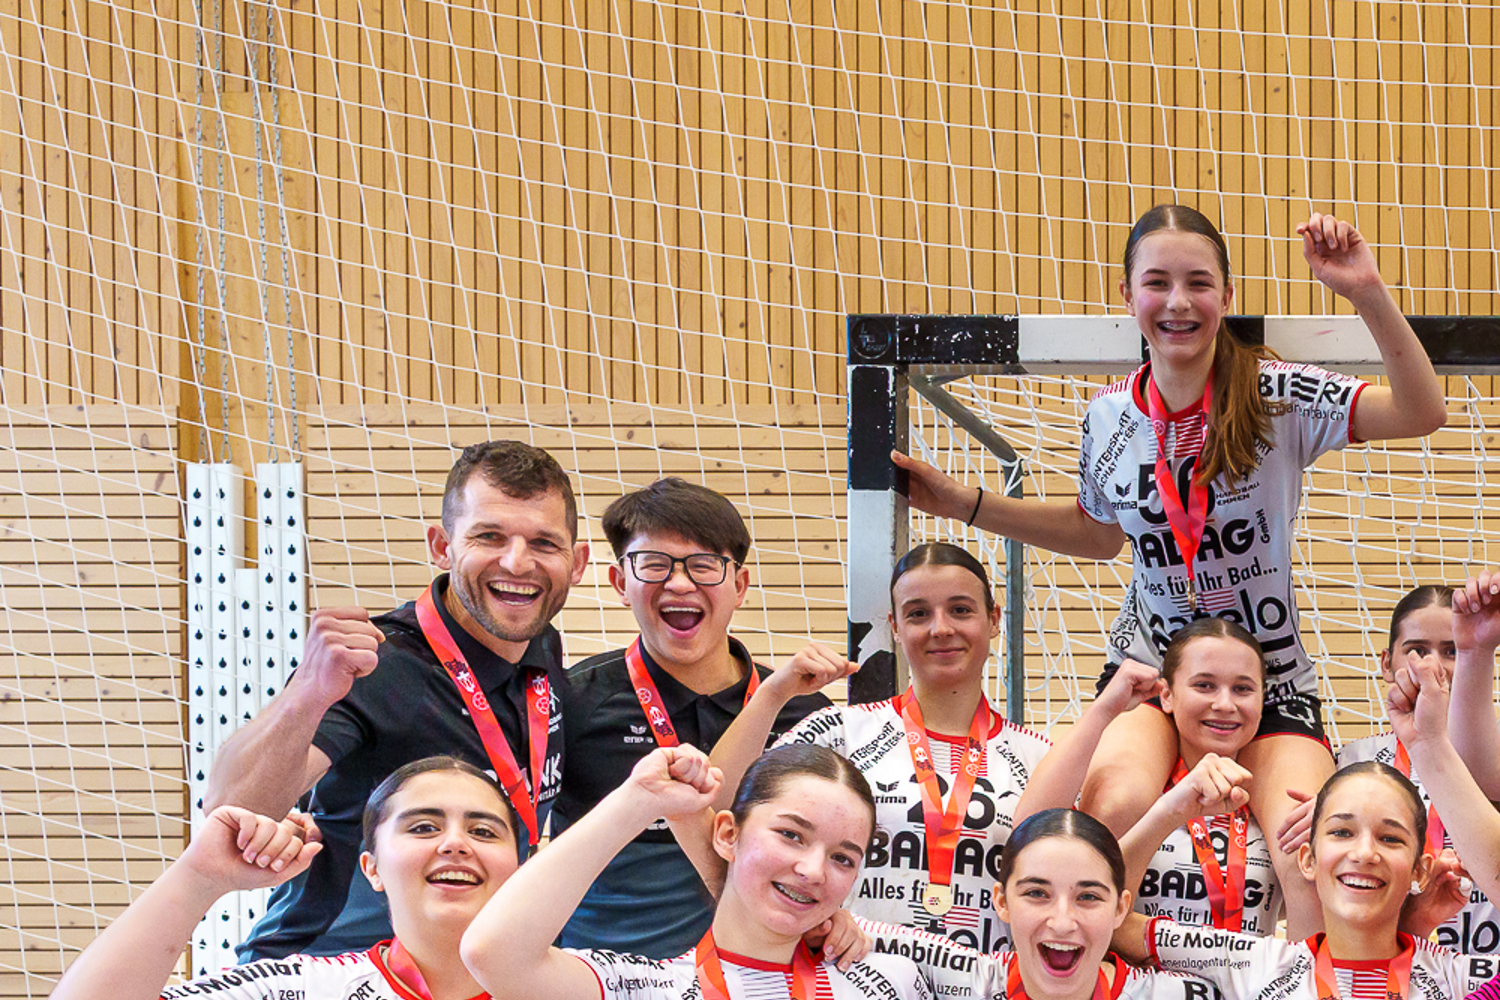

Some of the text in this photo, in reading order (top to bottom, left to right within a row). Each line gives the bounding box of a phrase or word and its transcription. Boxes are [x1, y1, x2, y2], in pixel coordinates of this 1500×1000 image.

[1197, 571, 1223, 592] Ihr
[794, 712, 843, 745] obiliar
[851, 721, 895, 762] TERSPORT
[875, 795, 907, 804] rima
[907, 774, 995, 830] 26
[859, 877, 905, 900] Alles
[1178, 906, 1199, 923] für
[1155, 928, 1181, 948] die
[876, 936, 978, 973] Mobiliar
[936, 982, 972, 997] uzern
